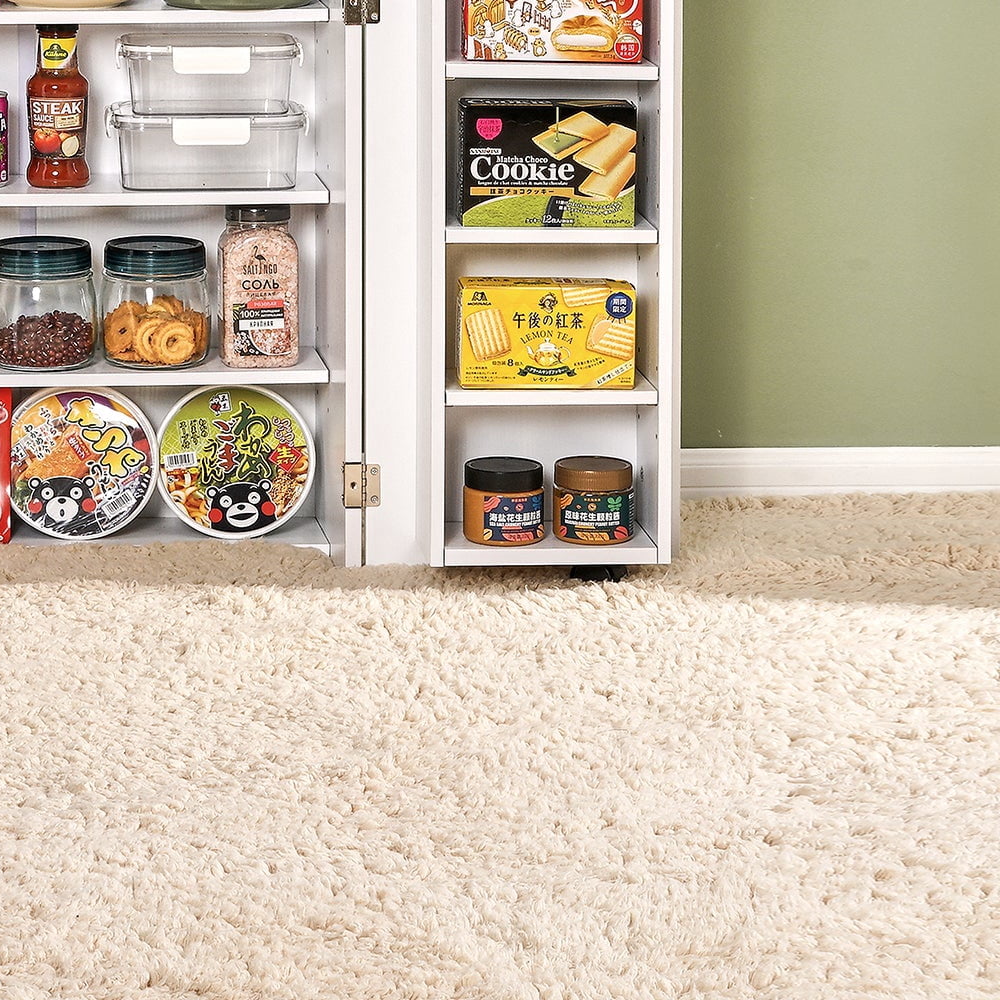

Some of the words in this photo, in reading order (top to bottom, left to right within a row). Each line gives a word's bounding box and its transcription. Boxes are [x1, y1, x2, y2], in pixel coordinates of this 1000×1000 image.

[32, 101, 82, 115] STEAK
[33, 113, 54, 123] SAUCE
[496, 155, 524, 163] Matcha
[525, 156, 549, 164] Choco
[470, 156, 575, 181] Cookie
[241, 279, 280, 290] СОЛЬ
[512, 310, 585, 330] 午後の紅茶
[519, 330, 554, 345] LEMON
[557, 330, 574, 345] TEA
[276, 446, 295, 459] 生
